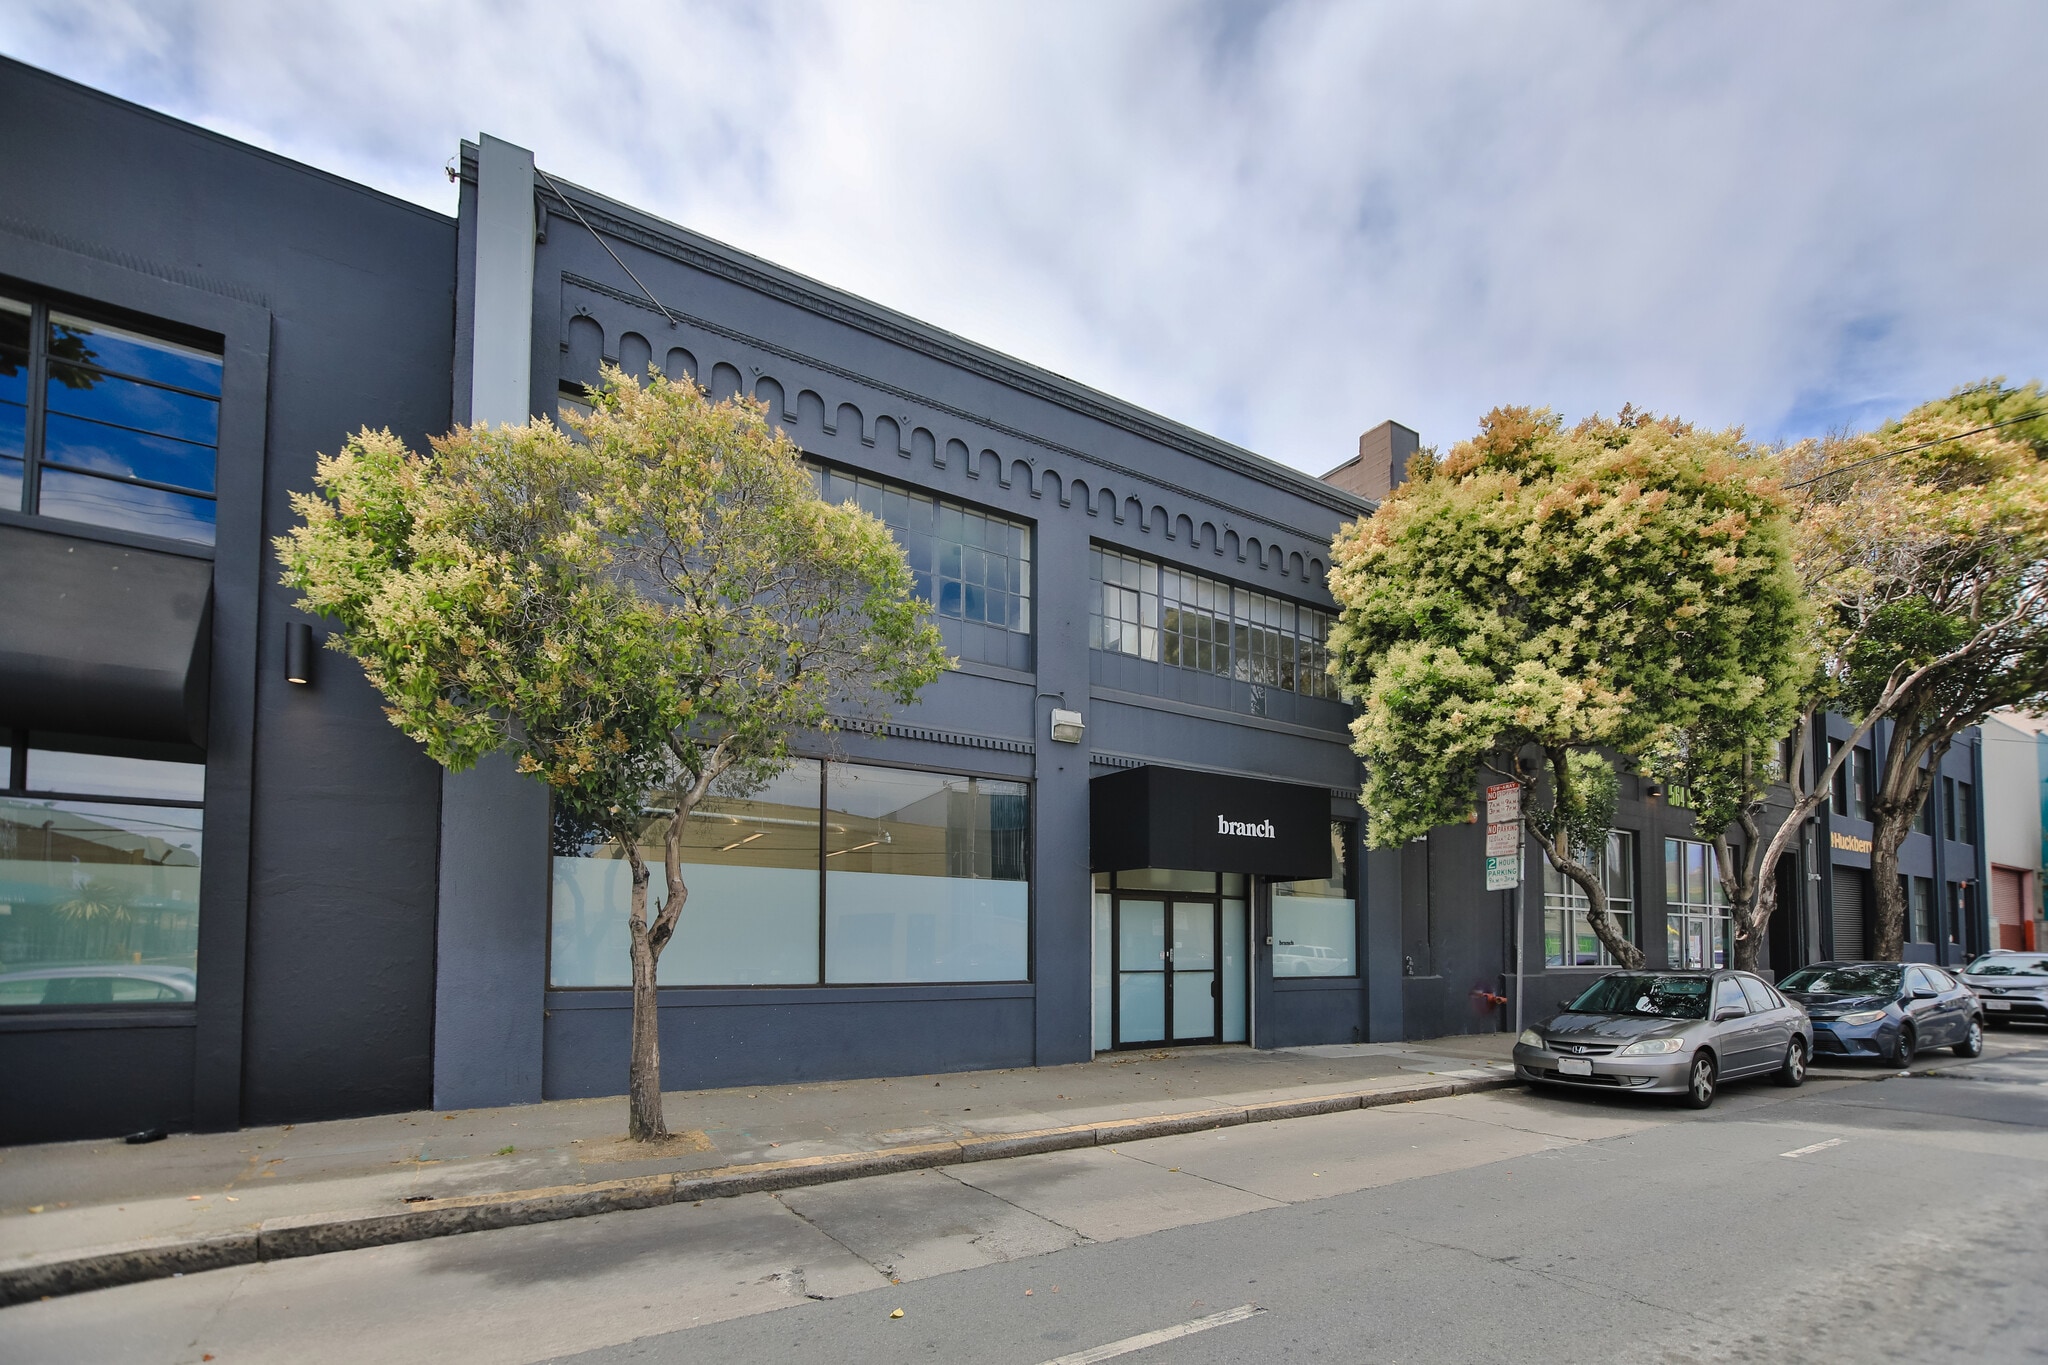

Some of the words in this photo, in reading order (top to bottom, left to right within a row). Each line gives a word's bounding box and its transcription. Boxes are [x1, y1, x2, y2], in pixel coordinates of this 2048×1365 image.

[1490, 783, 1515, 791] TOW-AWAY
[1488, 791, 1497, 800] NO
[1668, 784, 1685, 807] 564
[1217, 814, 1276, 839] branch
[1488, 824, 1497, 833] NO
[1498, 824, 1518, 832] PARKING
[1488, 858, 1496, 869] 2
[1498, 857, 1516, 867] HOUR
[1488, 867, 1517, 877] PARKING
